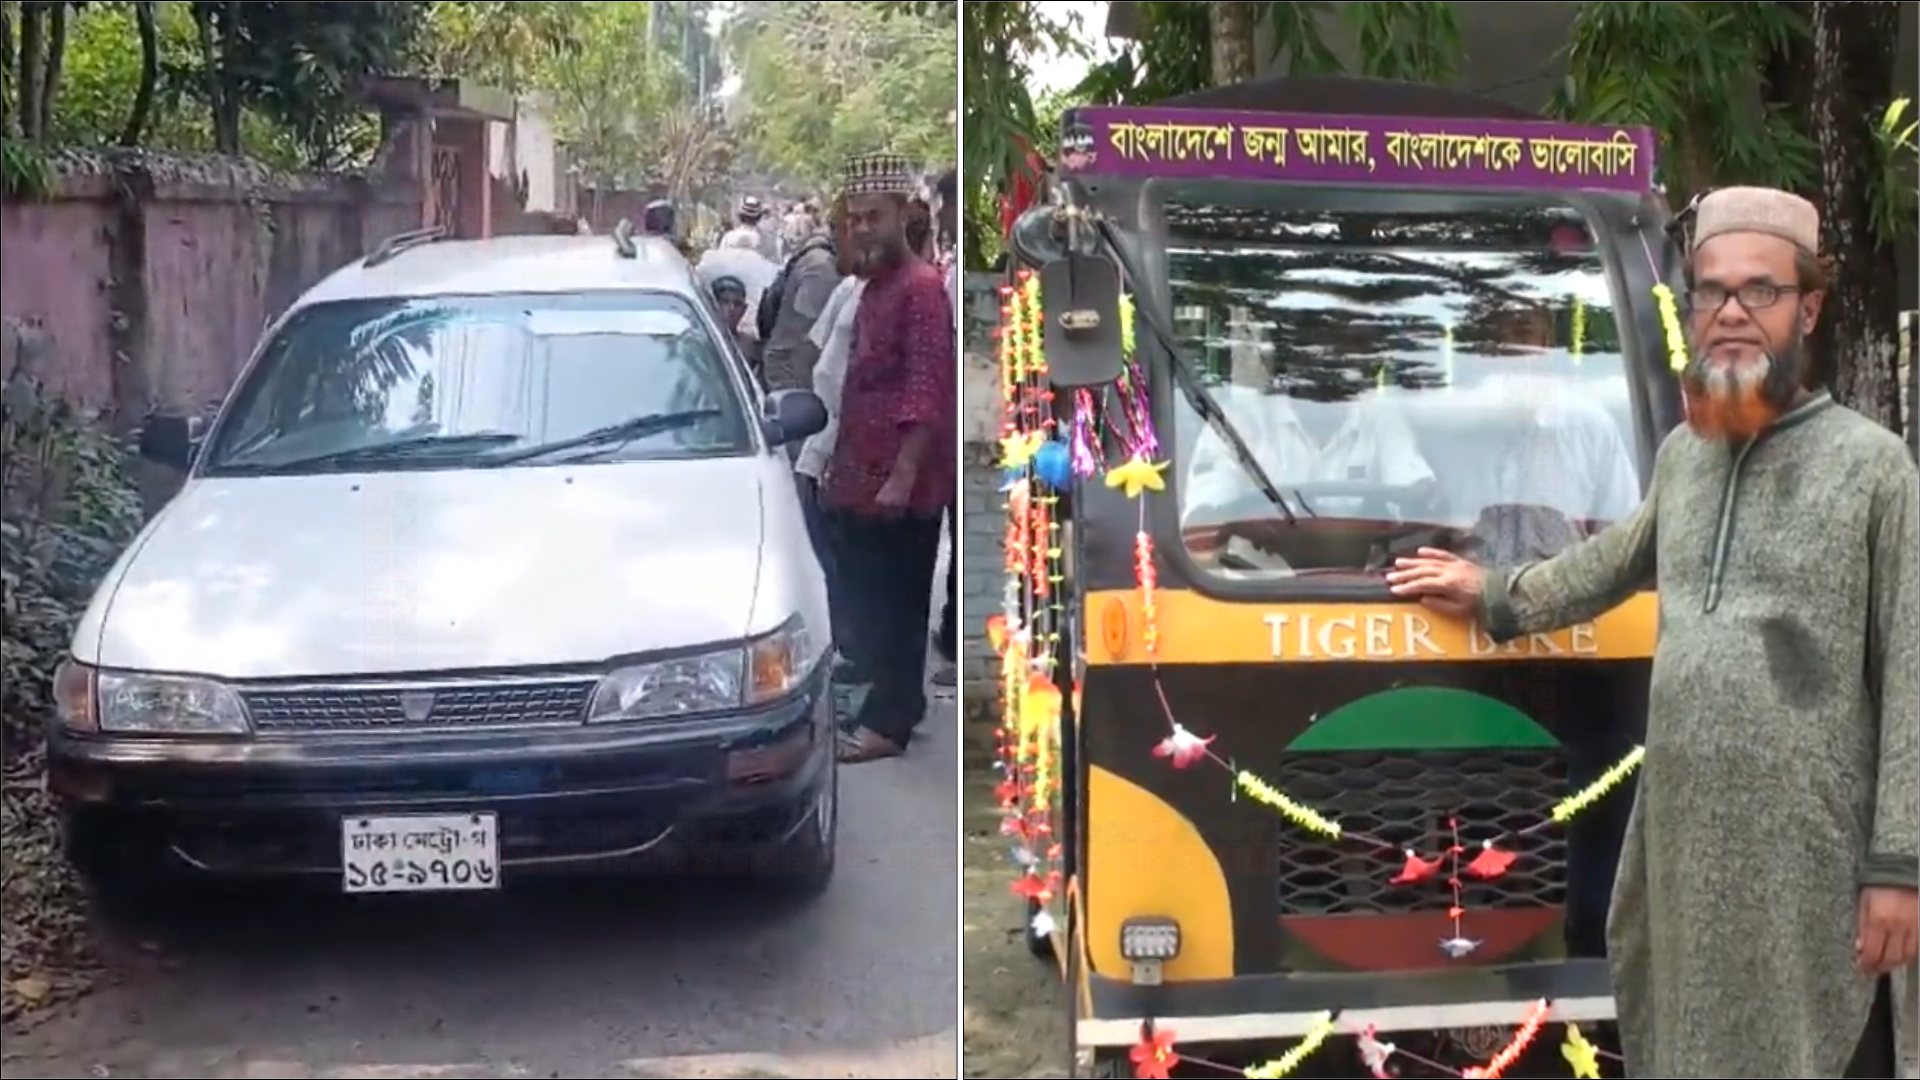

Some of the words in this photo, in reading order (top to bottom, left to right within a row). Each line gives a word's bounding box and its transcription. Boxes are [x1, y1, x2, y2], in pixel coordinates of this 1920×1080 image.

[1107, 119, 1235, 162] বাংলাদেশে
[1240, 126, 1289, 168] জন্ম
[1294, 124, 1376, 173] আমার,
[1384, 128, 1524, 172] বাংলাদেশকে
[1528, 130, 1639, 177] ভালোবাসি
[1262, 612, 1447, 657] TIGER
[350, 831, 397, 851] ঢাকা
[348, 858, 494, 888] ১৫-৯৭০৬
